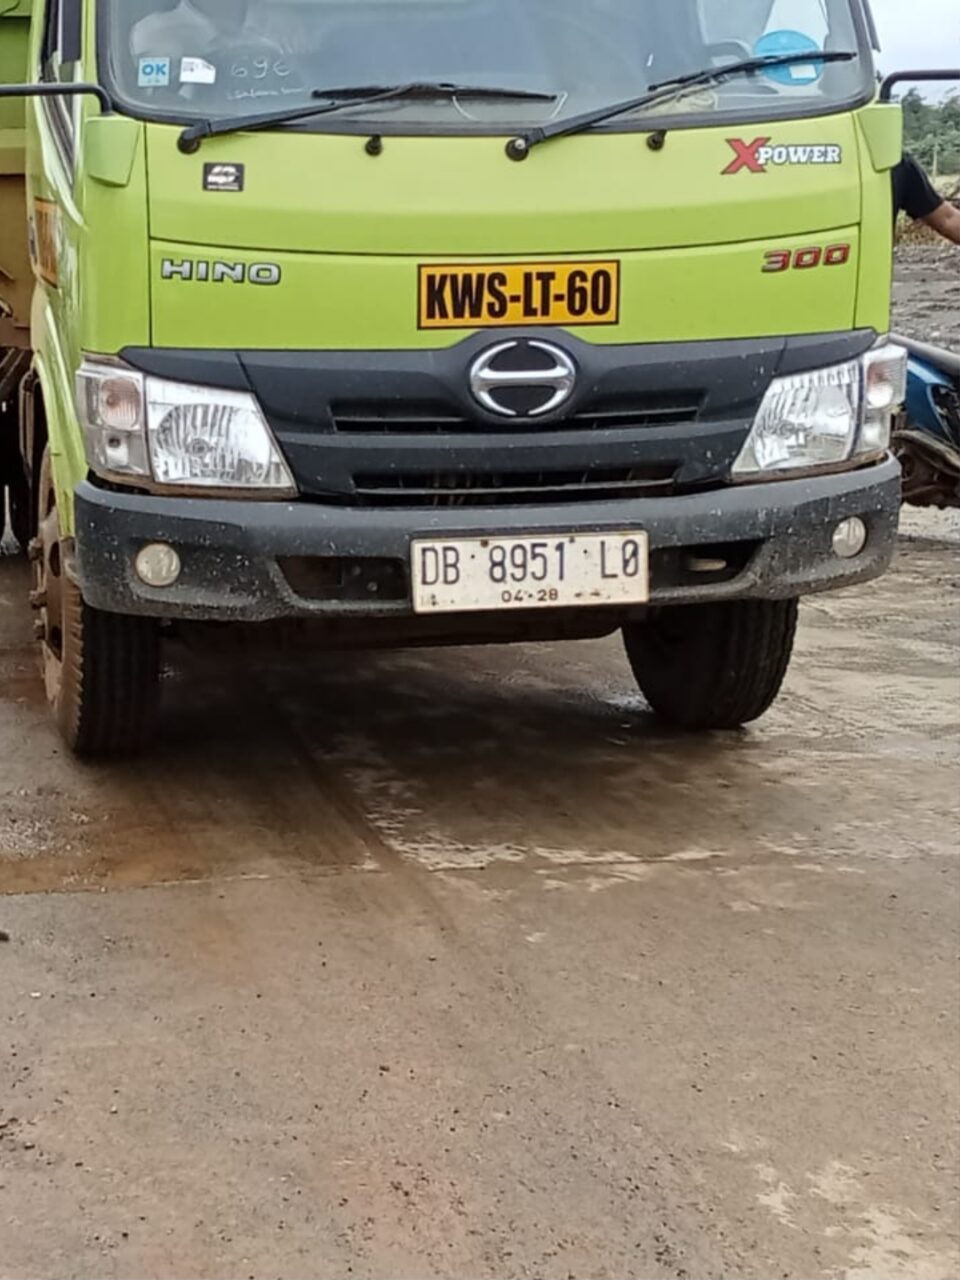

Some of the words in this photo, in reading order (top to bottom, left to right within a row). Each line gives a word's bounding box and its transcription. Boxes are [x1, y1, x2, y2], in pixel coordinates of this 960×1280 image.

[142, 63, 167, 76] OK
[161, 258, 281, 286] HINO
[761, 243, 851, 273] 300
[426, 269, 612, 320] KWS-LT-60
[421, 546, 460, 586] DB
[489, 541, 565, 583] 8951
